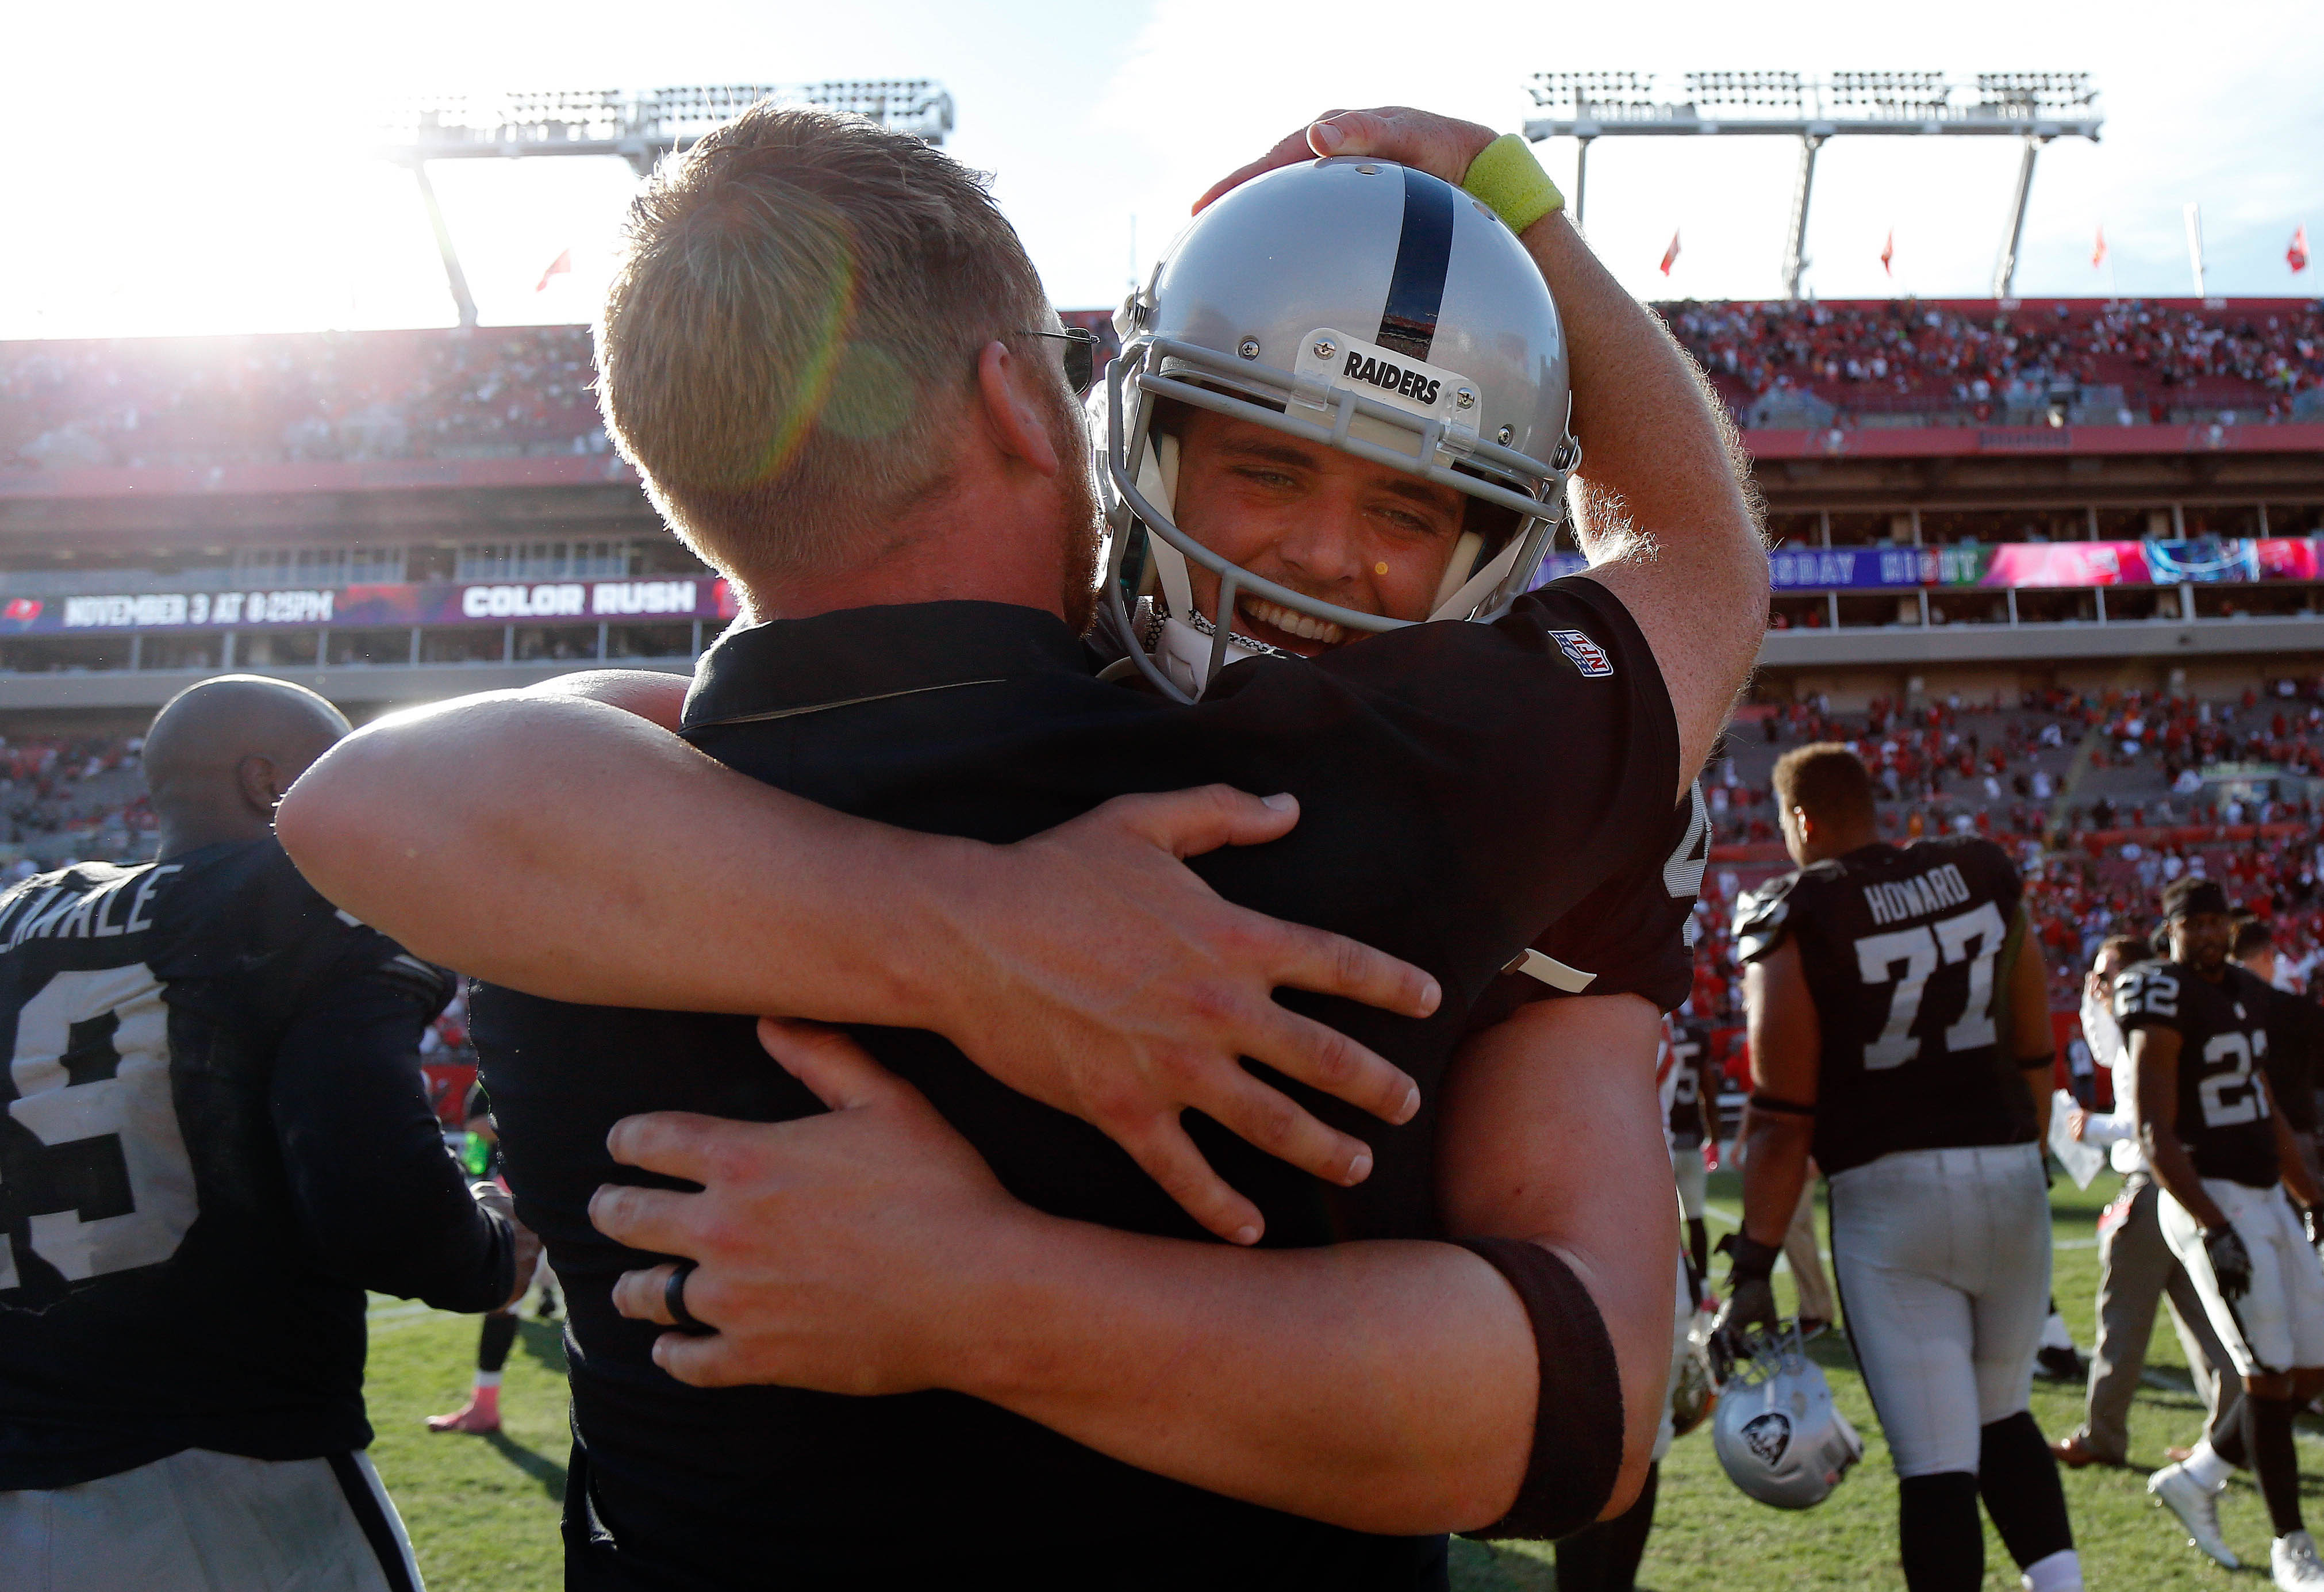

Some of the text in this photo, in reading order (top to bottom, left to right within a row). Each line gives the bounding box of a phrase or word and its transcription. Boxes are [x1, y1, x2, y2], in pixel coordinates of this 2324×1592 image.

[1343, 351, 1441, 406] RAIDERS
[1769, 550, 1977, 585] SDAY NIGHT
[64, 594, 188, 627] NOVEMBER
[189, 593, 209, 624] 3
[212, 592, 245, 624] AT
[462, 581, 697, 617] COLOR RUSH
[1571, 635, 1608, 670] NFL
[1864, 864, 1970, 924] HOWARD
[1854, 902, 2006, 1071] 77
[2114, 972, 2180, 1018] 22
[0, 962, 199, 1289] 9
